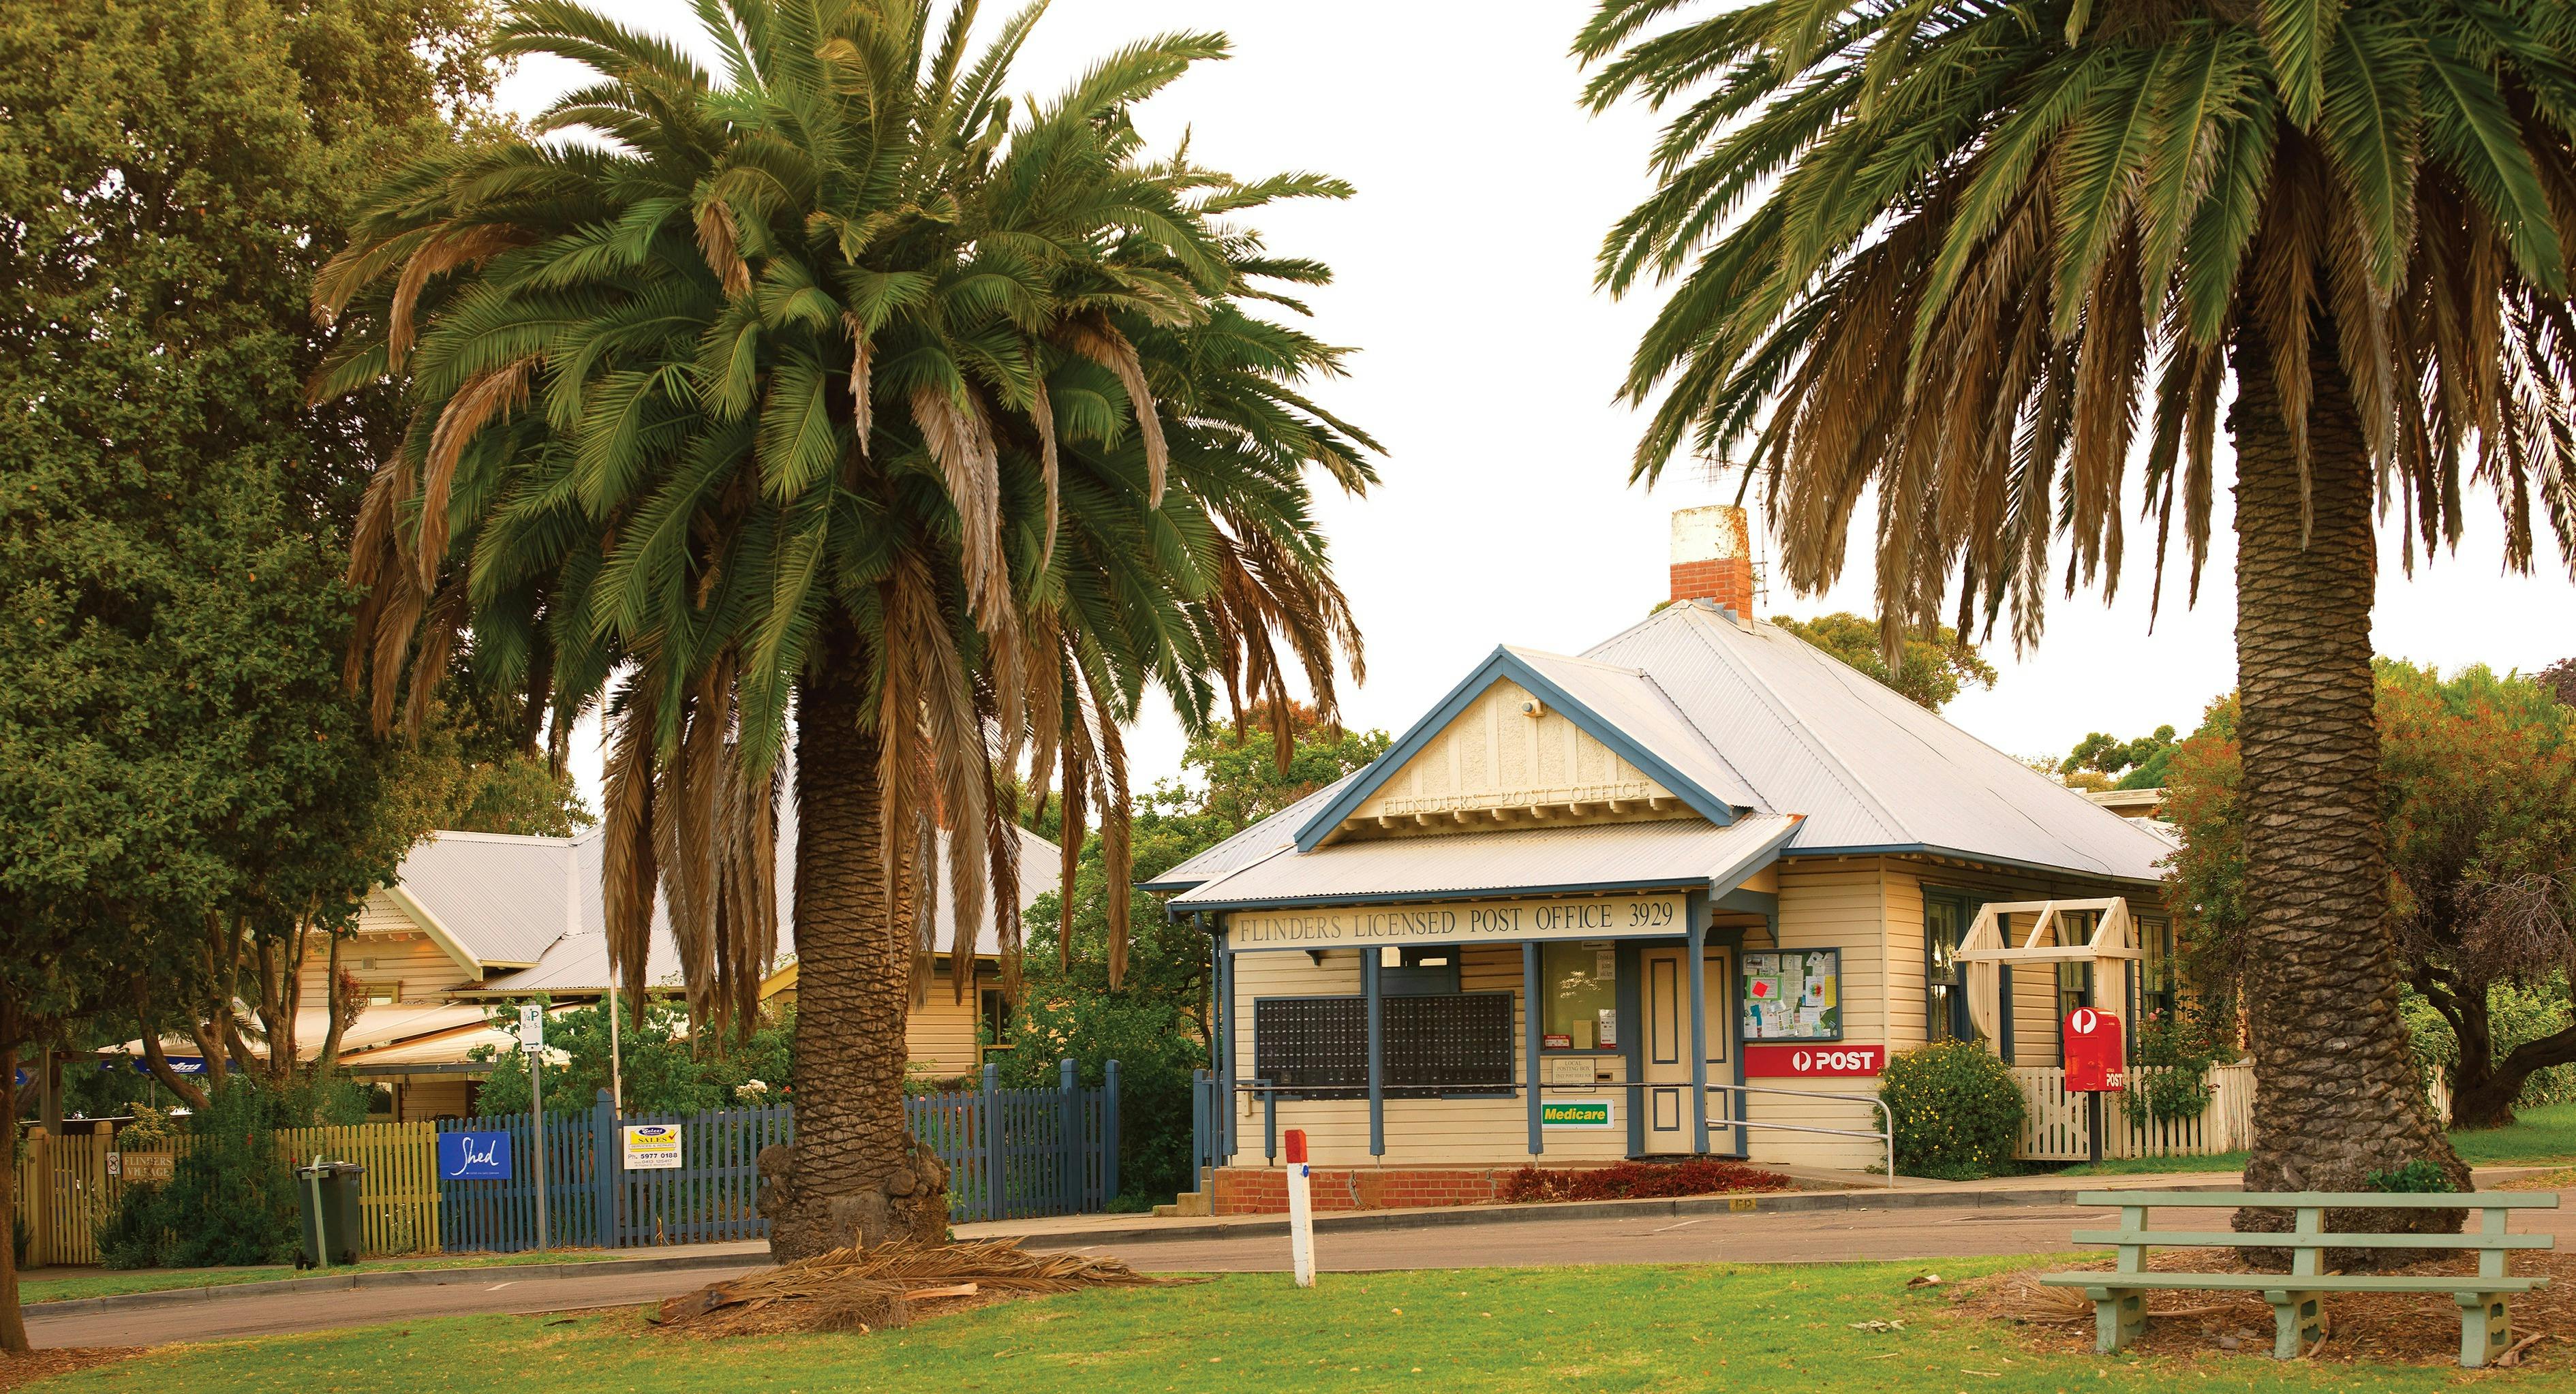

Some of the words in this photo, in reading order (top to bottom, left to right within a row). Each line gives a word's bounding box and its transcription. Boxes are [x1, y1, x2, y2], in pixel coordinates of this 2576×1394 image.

[1383, 793, 1480, 815] FLINDERS
[1499, 788, 1552, 807] POST
[1569, 782, 1649, 802] OFFICE
[1240, 916, 1341, 942] FLINDERS
[1354, 911, 1456, 938] LICENSED
[1470, 908, 1522, 933] POST
[1535, 904, 1613, 930] OFFICE
[1629, 902, 1673, 927] 3929
[1816, 1051, 1875, 1070] POST
[2106, 1073, 2123, 1087] POST
[1544, 1108, 1606, 1120] Medicare
[125, 1157, 172, 1166] FLINDERS
[450, 1136, 500, 1176] Shed
